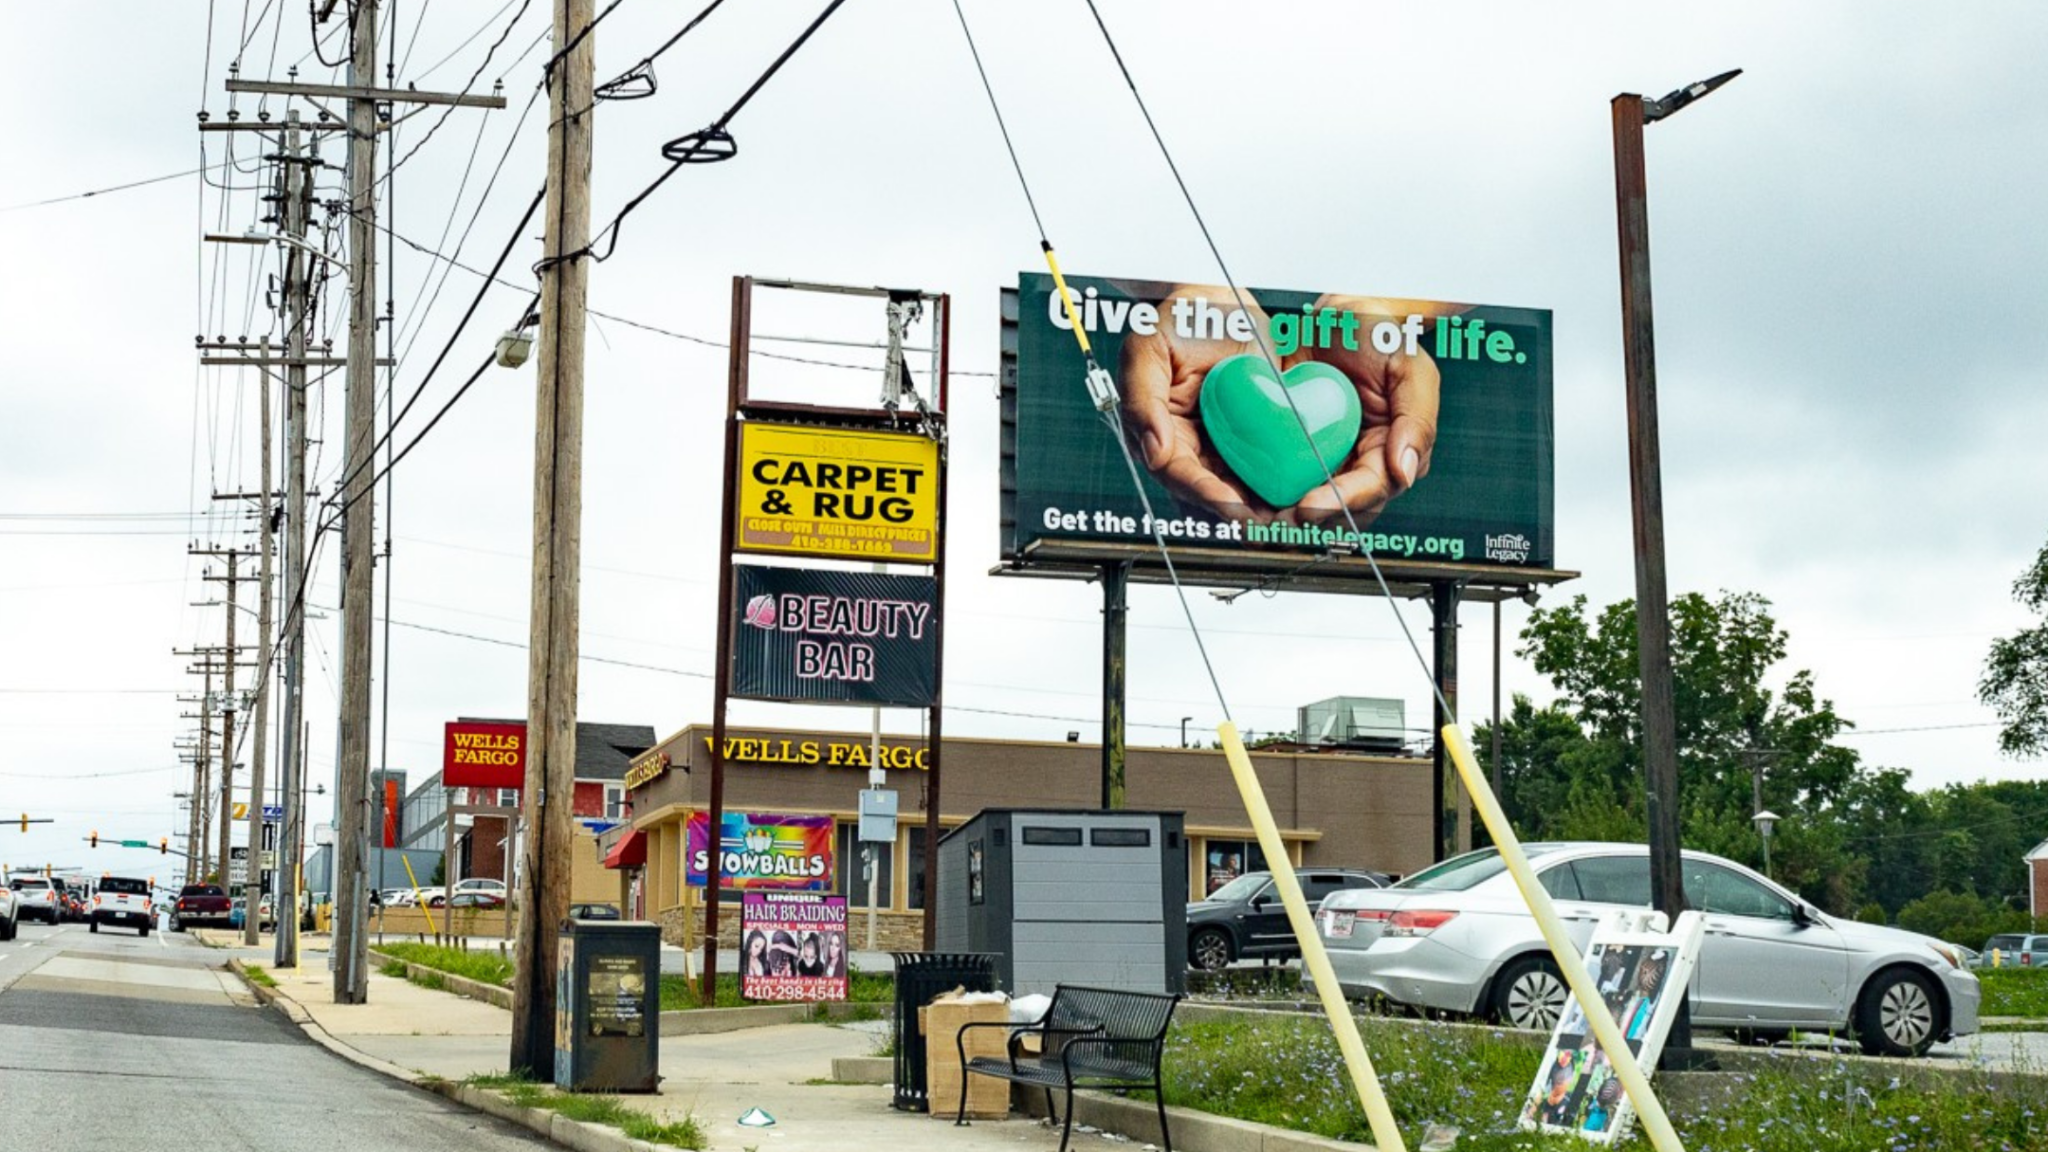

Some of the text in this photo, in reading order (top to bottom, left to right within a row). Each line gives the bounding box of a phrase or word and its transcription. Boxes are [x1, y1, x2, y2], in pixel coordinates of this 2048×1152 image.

[1048, 286, 1527, 364] Give the gift of life.
[752, 459, 924, 494] CARPET
[761, 489, 914, 523] & RUG
[1043, 507, 1464, 560] Get the facts at infinitelegacy.org
[1485, 534, 1531, 550] Infinite
[1485, 547, 1529, 564] Legacy
[779, 593, 930, 640] BEAUTY
[797, 640, 875, 681] BAR
[453, 733, 520, 750] WELLS
[453, 748, 519, 766] FARGO
[766, 894, 823, 902] UNIQUE
[744, 903, 846, 922] HAIR BRAIDING
[746, 922, 790, 931] SPECIALS
[796, 923, 818, 931] MON
[823, 923, 846, 931] WED
[744, 985, 846, 1000] 410-298-4544
